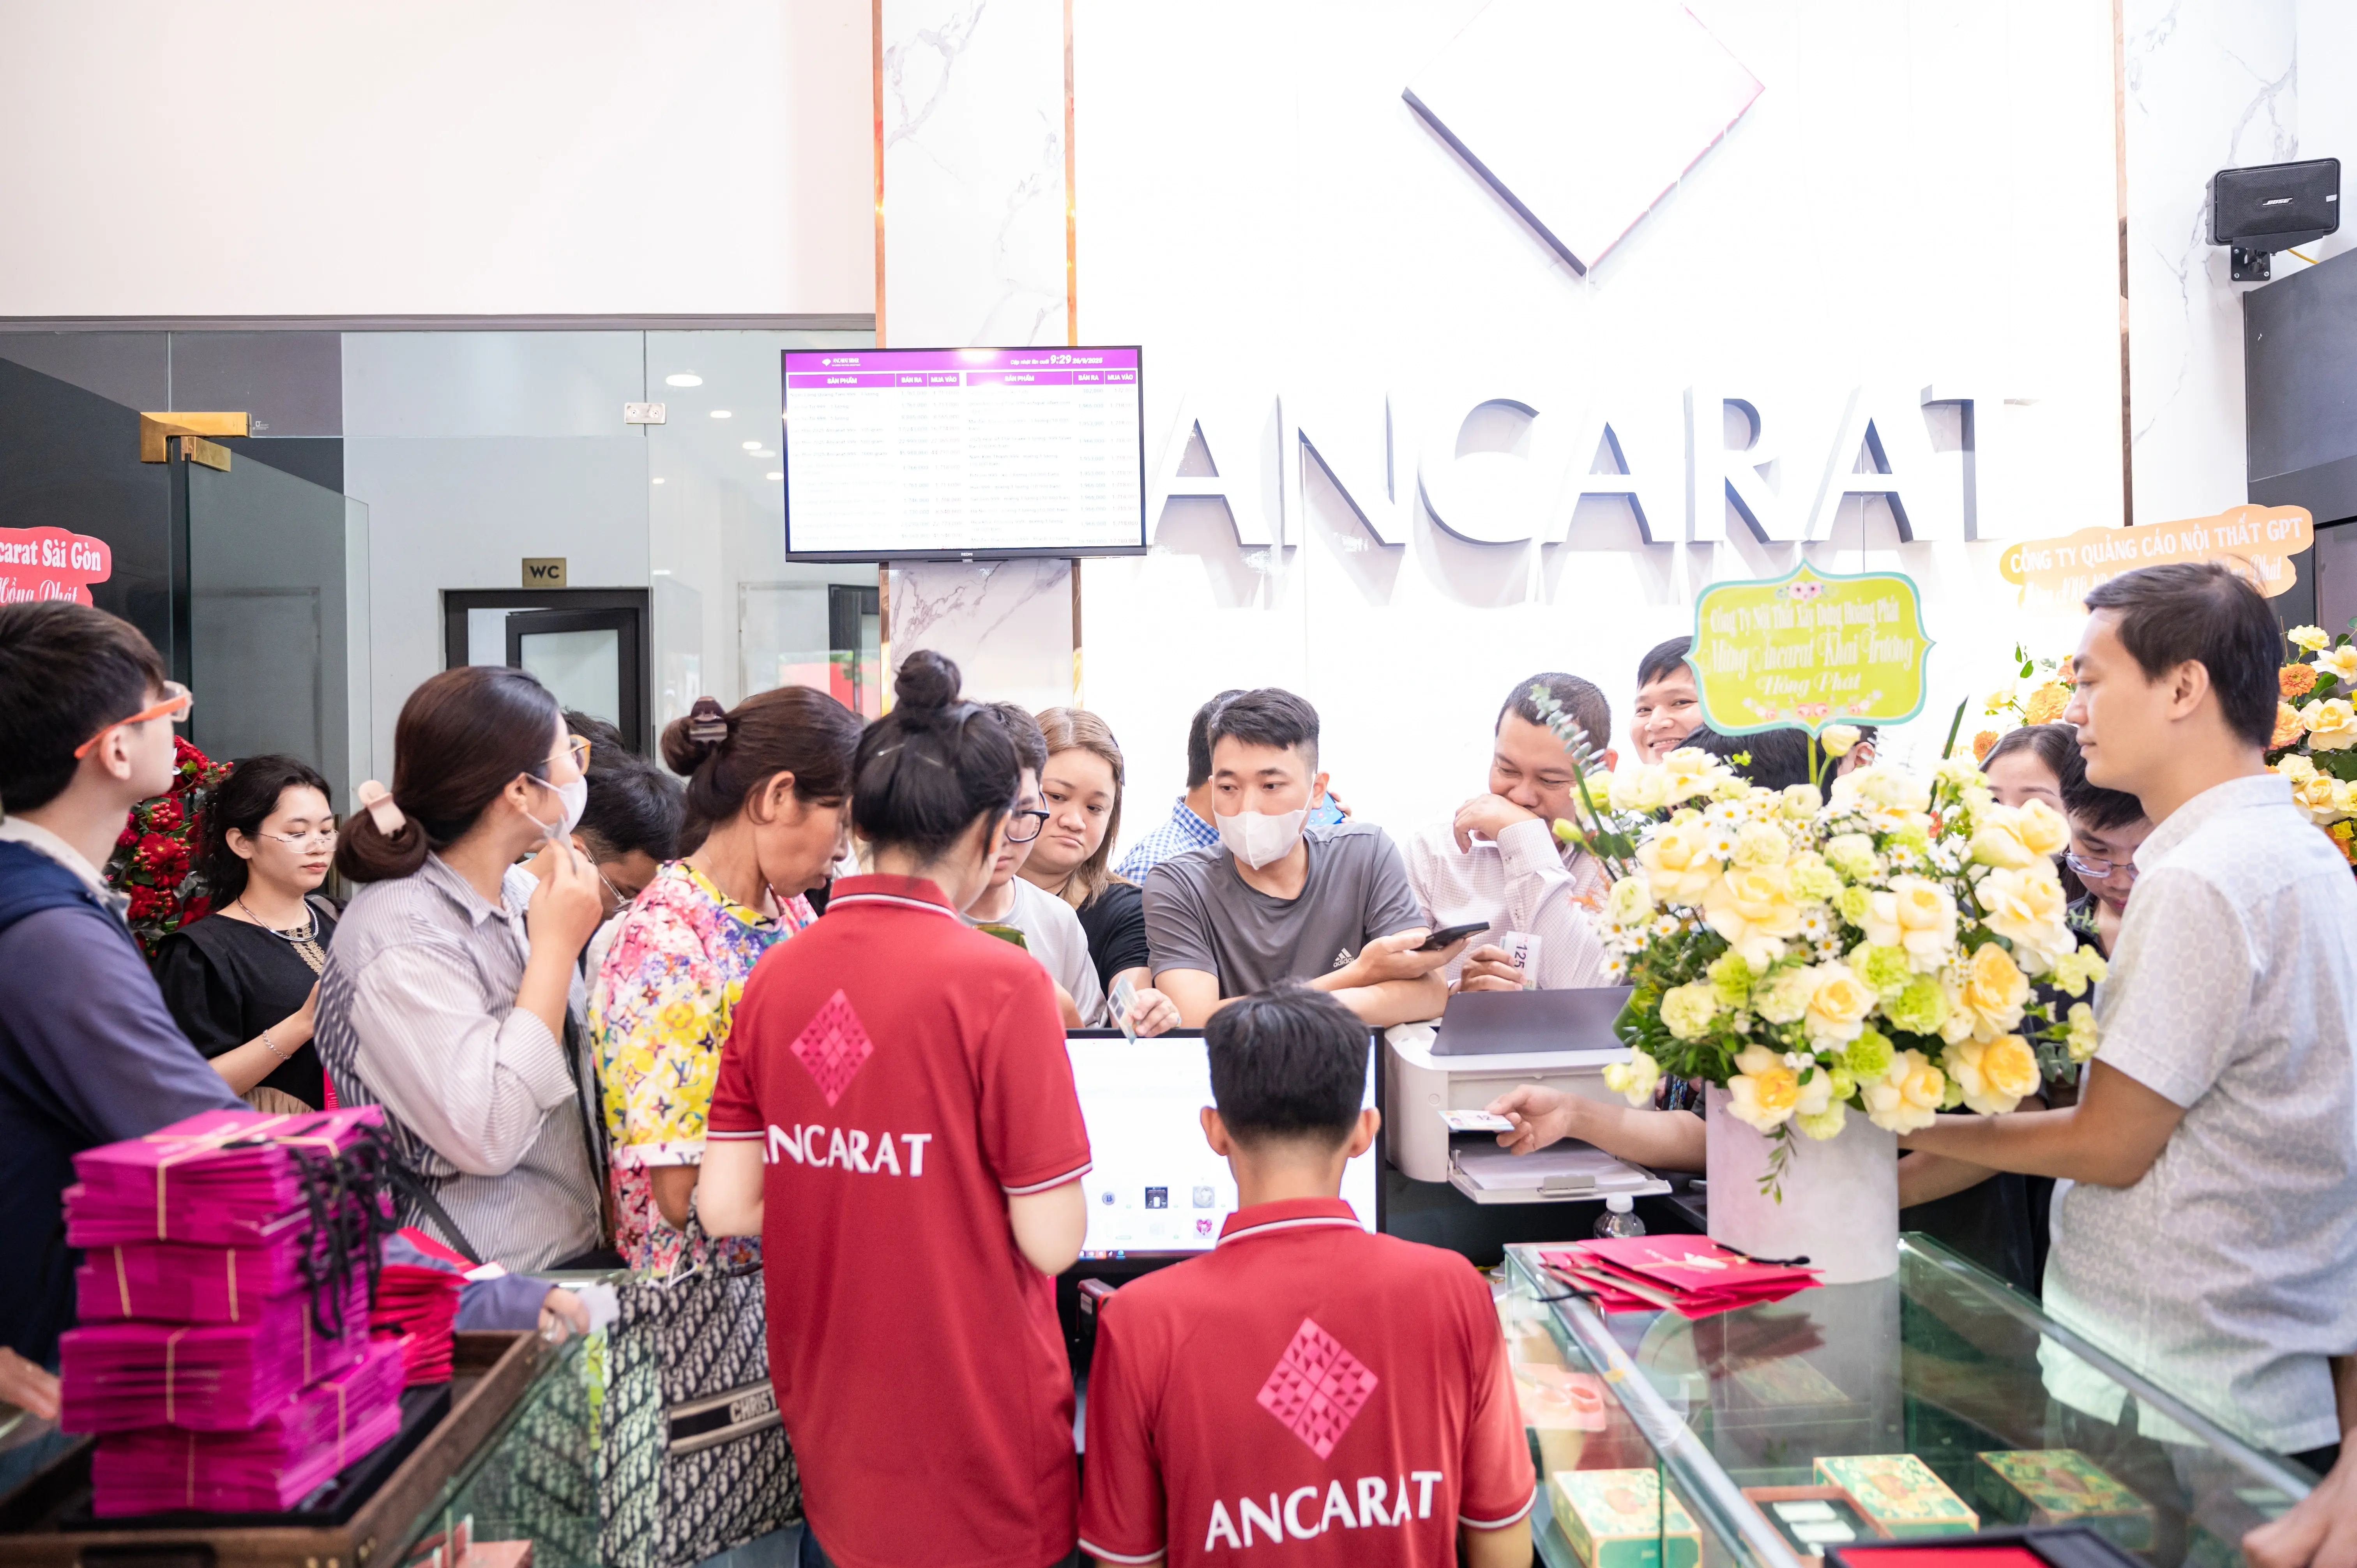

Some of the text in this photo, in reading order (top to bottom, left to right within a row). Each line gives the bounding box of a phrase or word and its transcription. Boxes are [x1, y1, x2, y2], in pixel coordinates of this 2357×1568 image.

[1050, 354, 1072, 364] 9:29
[1148, 386, 2040, 546] ANCARAT
[42, 539, 67, 568] Sài
[71, 542, 101, 571] Gòn
[2010, 512, 2303, 574] CÔNG TY QUẢNG CÁO NỘI THẤT GPT
[530, 566, 560, 579] WC
[2250, 554, 2282, 583] Phát
[39, 579, 78, 602] Phát
[1710, 605, 1737, 638] Công
[1737, 607, 1751, 636] Ty
[1817, 631, 1859, 667] Khai
[1333, 957, 1355, 968] adidas
[1514, 945, 1527, 969] 125
[762, 1124, 932, 1177] NCARAT
[1204, 1471, 1443, 1552] ANCARAT
